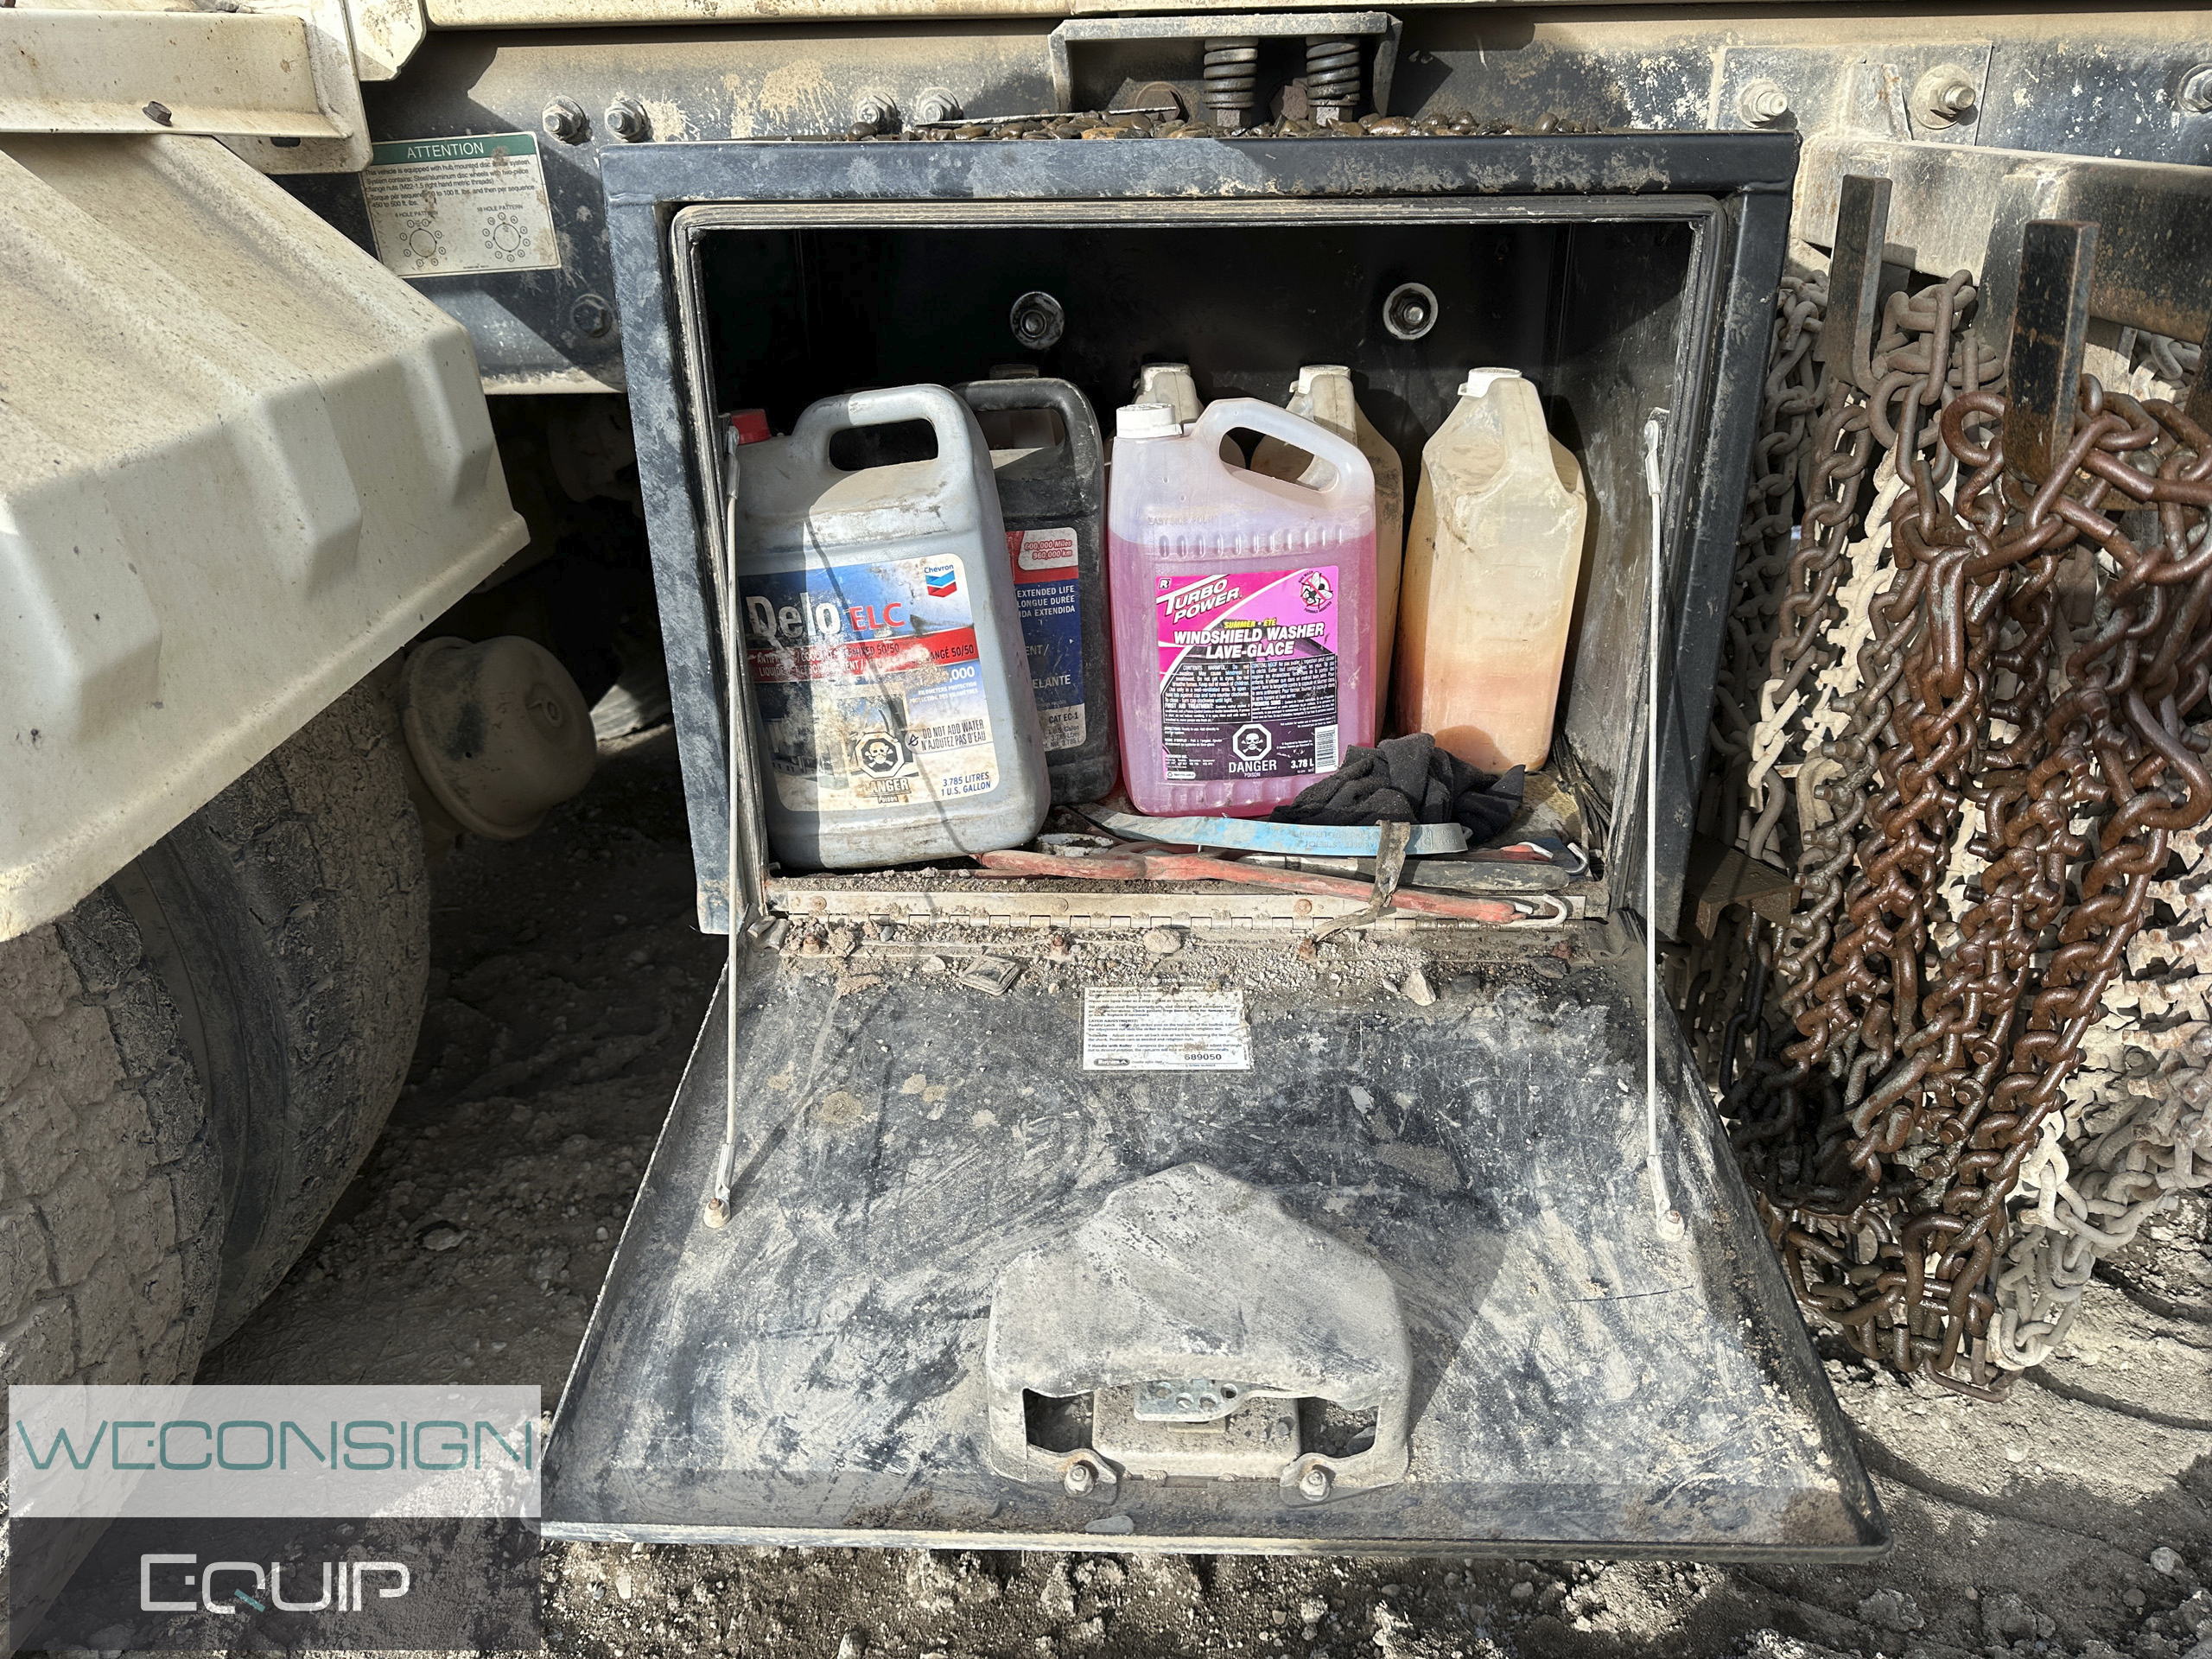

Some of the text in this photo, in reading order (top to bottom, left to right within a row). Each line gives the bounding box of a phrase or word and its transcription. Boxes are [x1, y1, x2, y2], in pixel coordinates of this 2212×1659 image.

[407, 142, 484, 159] ATTENTION
[404, 166, 429, 175] equipped
[366, 177, 387, 186] System
[1054, 539, 1072, 548] Miles
[1033, 549, 1072, 560] 960,000 km
[925, 564, 954, 574] Chevron
[1017, 585, 1075, 598] EXTENDED LIFE
[1158, 577, 1228, 616] TURBO
[1017, 594, 1075, 607] LONGUE DURÉE
[746, 592, 906, 639] Delo ELC
[1035, 605, 1075, 616] EXTENDIDA
[1224, 618, 1277, 629] SUMMER ÉTÉ
[1174, 622, 1325, 645] WINDSHIELD WASHER
[951, 644, 975, 657] 50/50
[1206, 641, 1294, 659] LAVE-GLACE
[949, 682, 976, 691] PROTECTION
[1049, 712, 1078, 724] CAT EC-1
[923, 719, 984, 739] DO NOT ADD WATER
[920, 731, 986, 751] N'AJOUTEZ PAS D'EAU
[1229, 760, 1277, 772] DANGER
[1291, 760, 1307, 769] 3.78
[943, 772, 989, 786] 3.785 LITRES
[862, 778, 910, 794] ANGER
[946, 786, 961, 796] U.S.
[963, 781, 991, 793] GALLON
